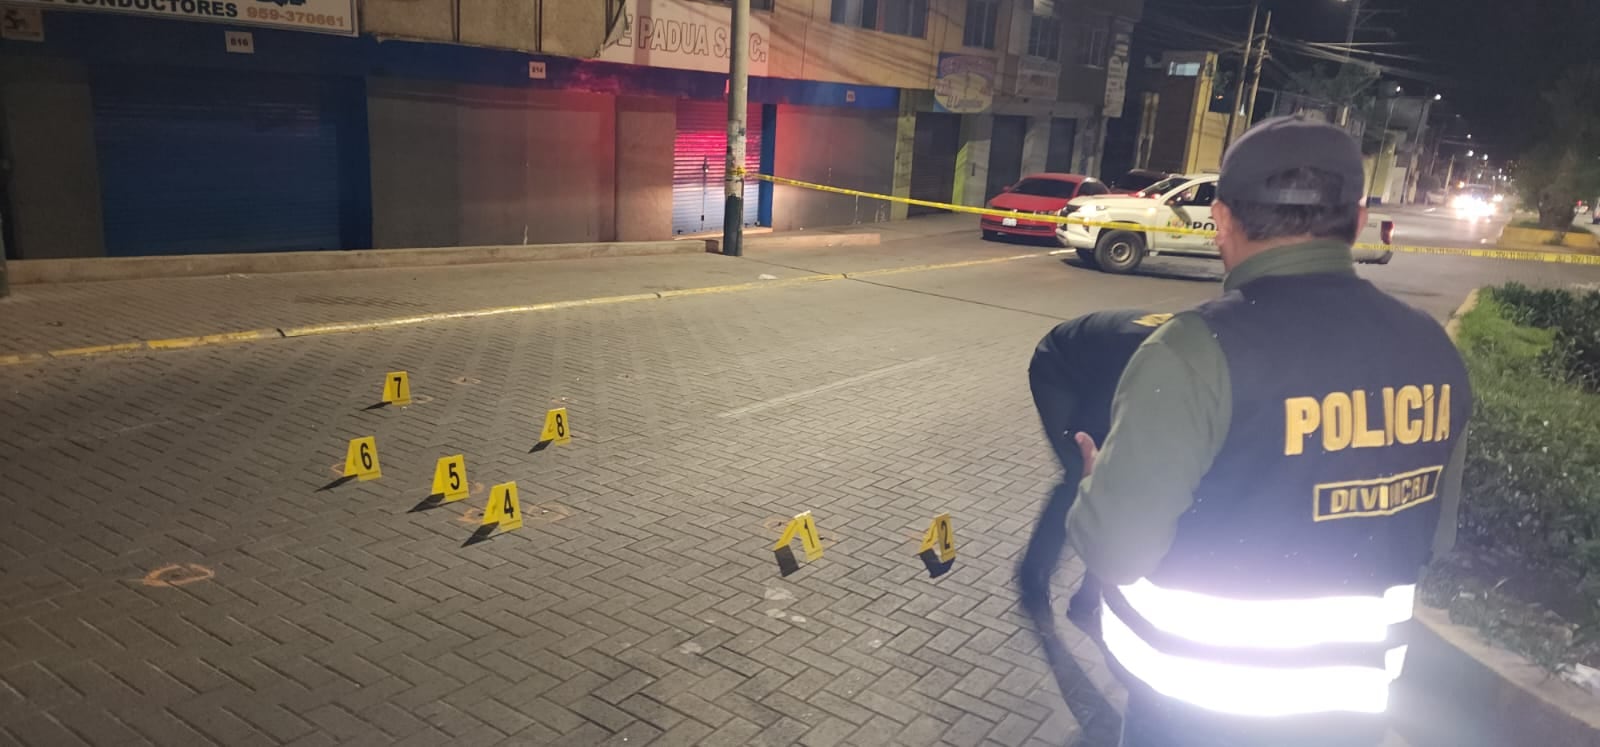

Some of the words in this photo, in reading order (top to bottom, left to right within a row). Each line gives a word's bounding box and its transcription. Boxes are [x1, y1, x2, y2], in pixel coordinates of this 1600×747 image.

[65, 0, 238, 18] DUCTORES
[617, 14, 633, 48] E
[638, 16, 709, 56] PADUA
[393, 376, 402, 398] 7
[555, 413, 565, 438] 8
[360, 442, 373, 470] 6
[448, 462, 460, 490] 5
[503, 488, 514, 519] 4
[803, 518, 815, 549] 1
[939, 519, 951, 550] 2
